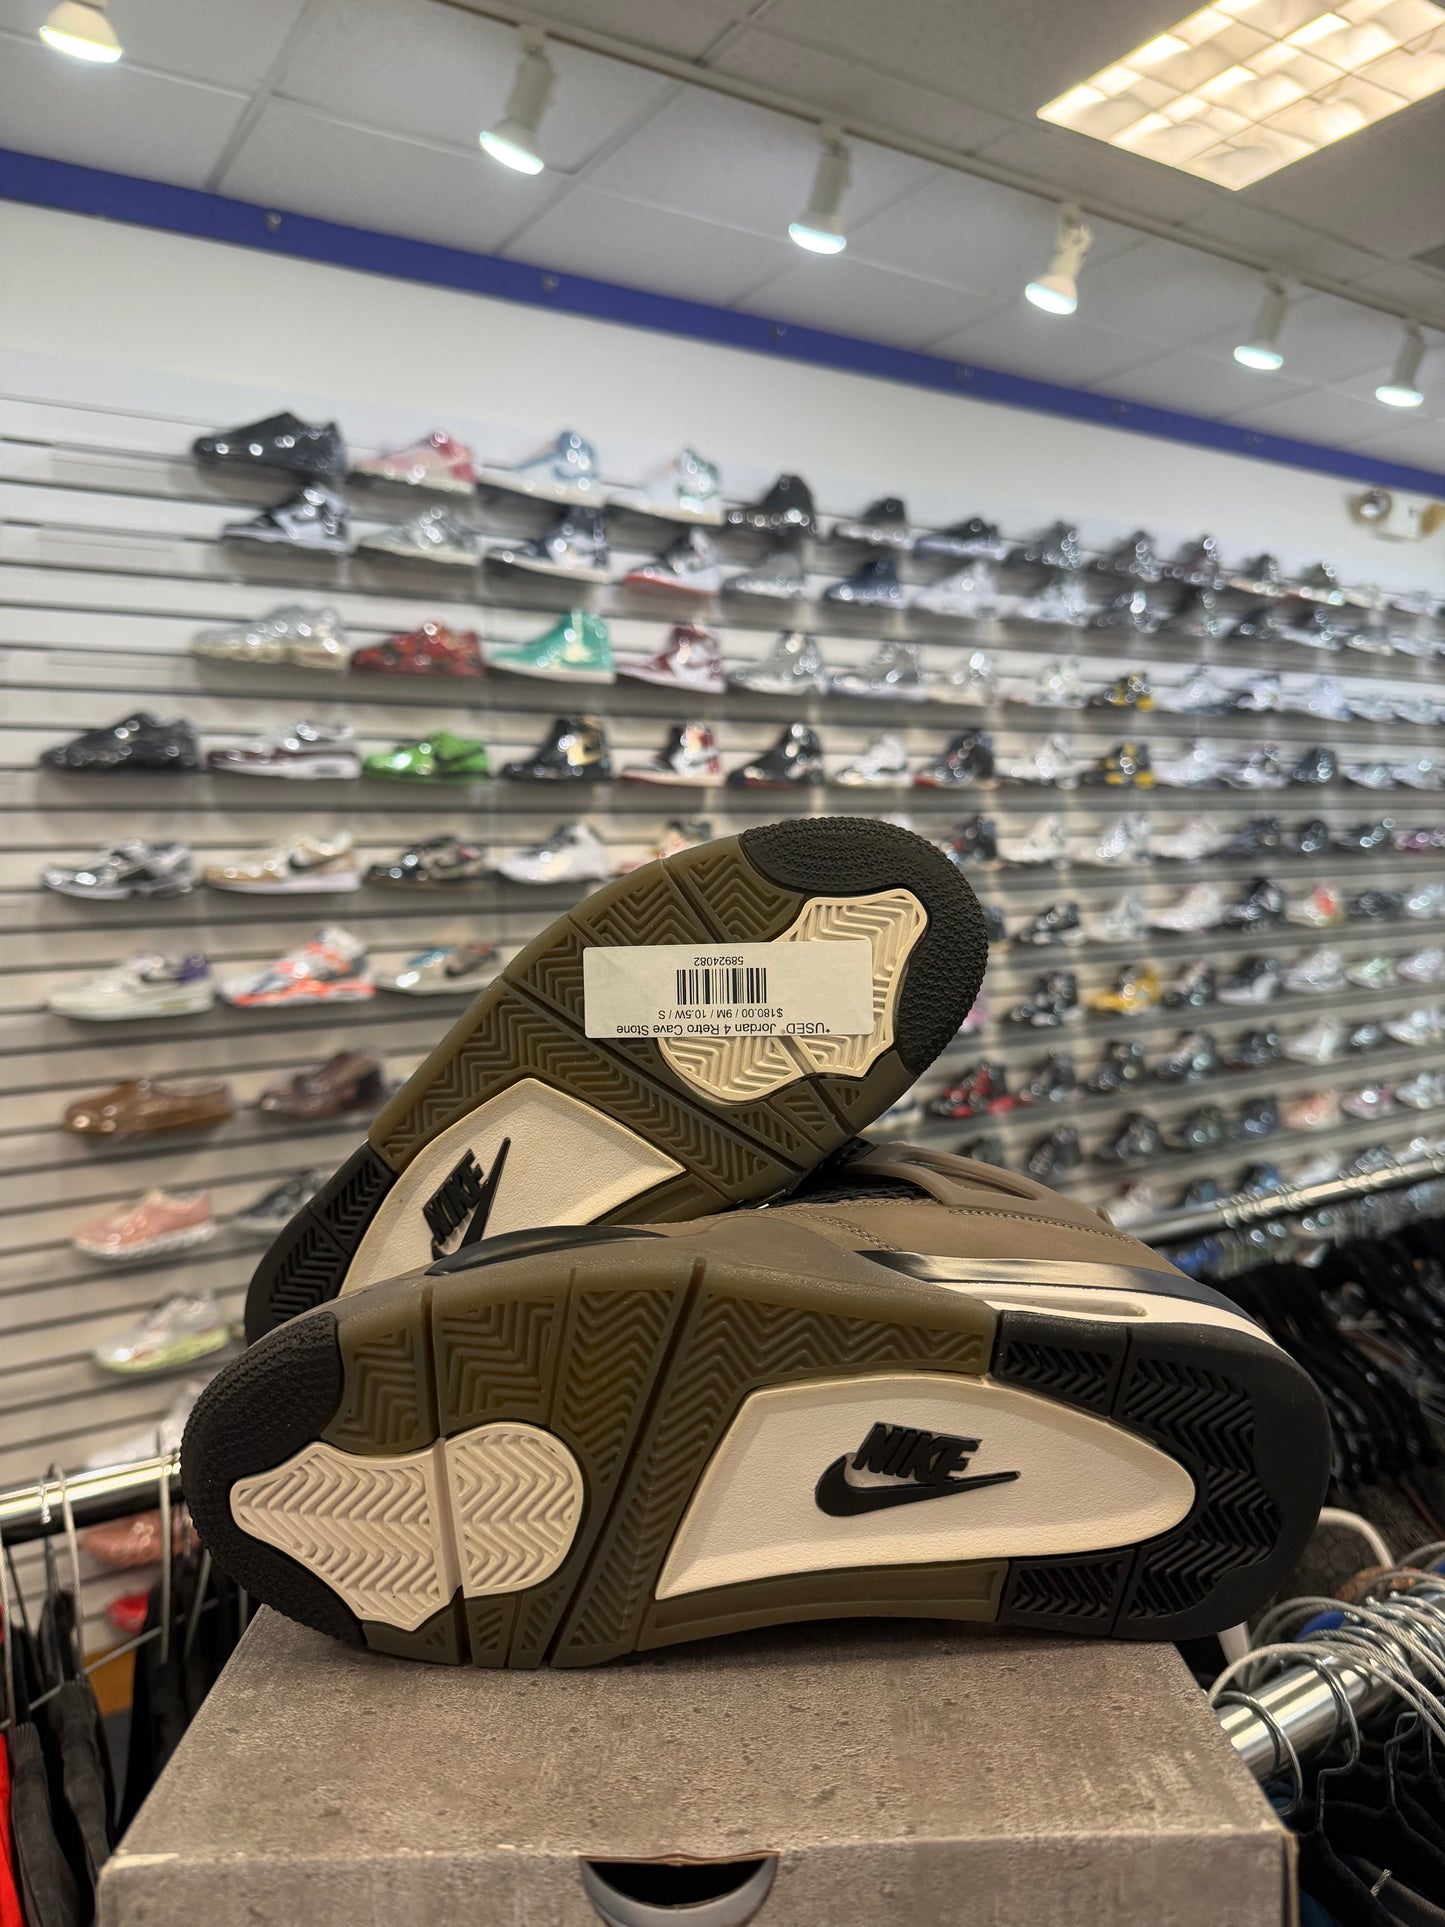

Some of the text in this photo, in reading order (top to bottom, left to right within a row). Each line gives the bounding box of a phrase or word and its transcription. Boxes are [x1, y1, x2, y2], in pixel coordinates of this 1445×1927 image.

[693, 956, 744, 967] 58924082
[658, 1010, 666, 1020] S
[674, 1010, 707, 1019] 10.5W
[716, 1009, 732, 1018] 9M
[741, 1008, 784, 1018] $180.00
[616, 1024, 649, 1036] Stone
[653, 1024, 683, 1036] Cave
[687, 1024, 720, 1036] Retro
[723, 1023, 732, 1035] 4
[735, 1023, 777, 1035] Jordan
[422, 1148, 485, 1246] NIKE
[851, 1422, 982, 1484] NIKE
